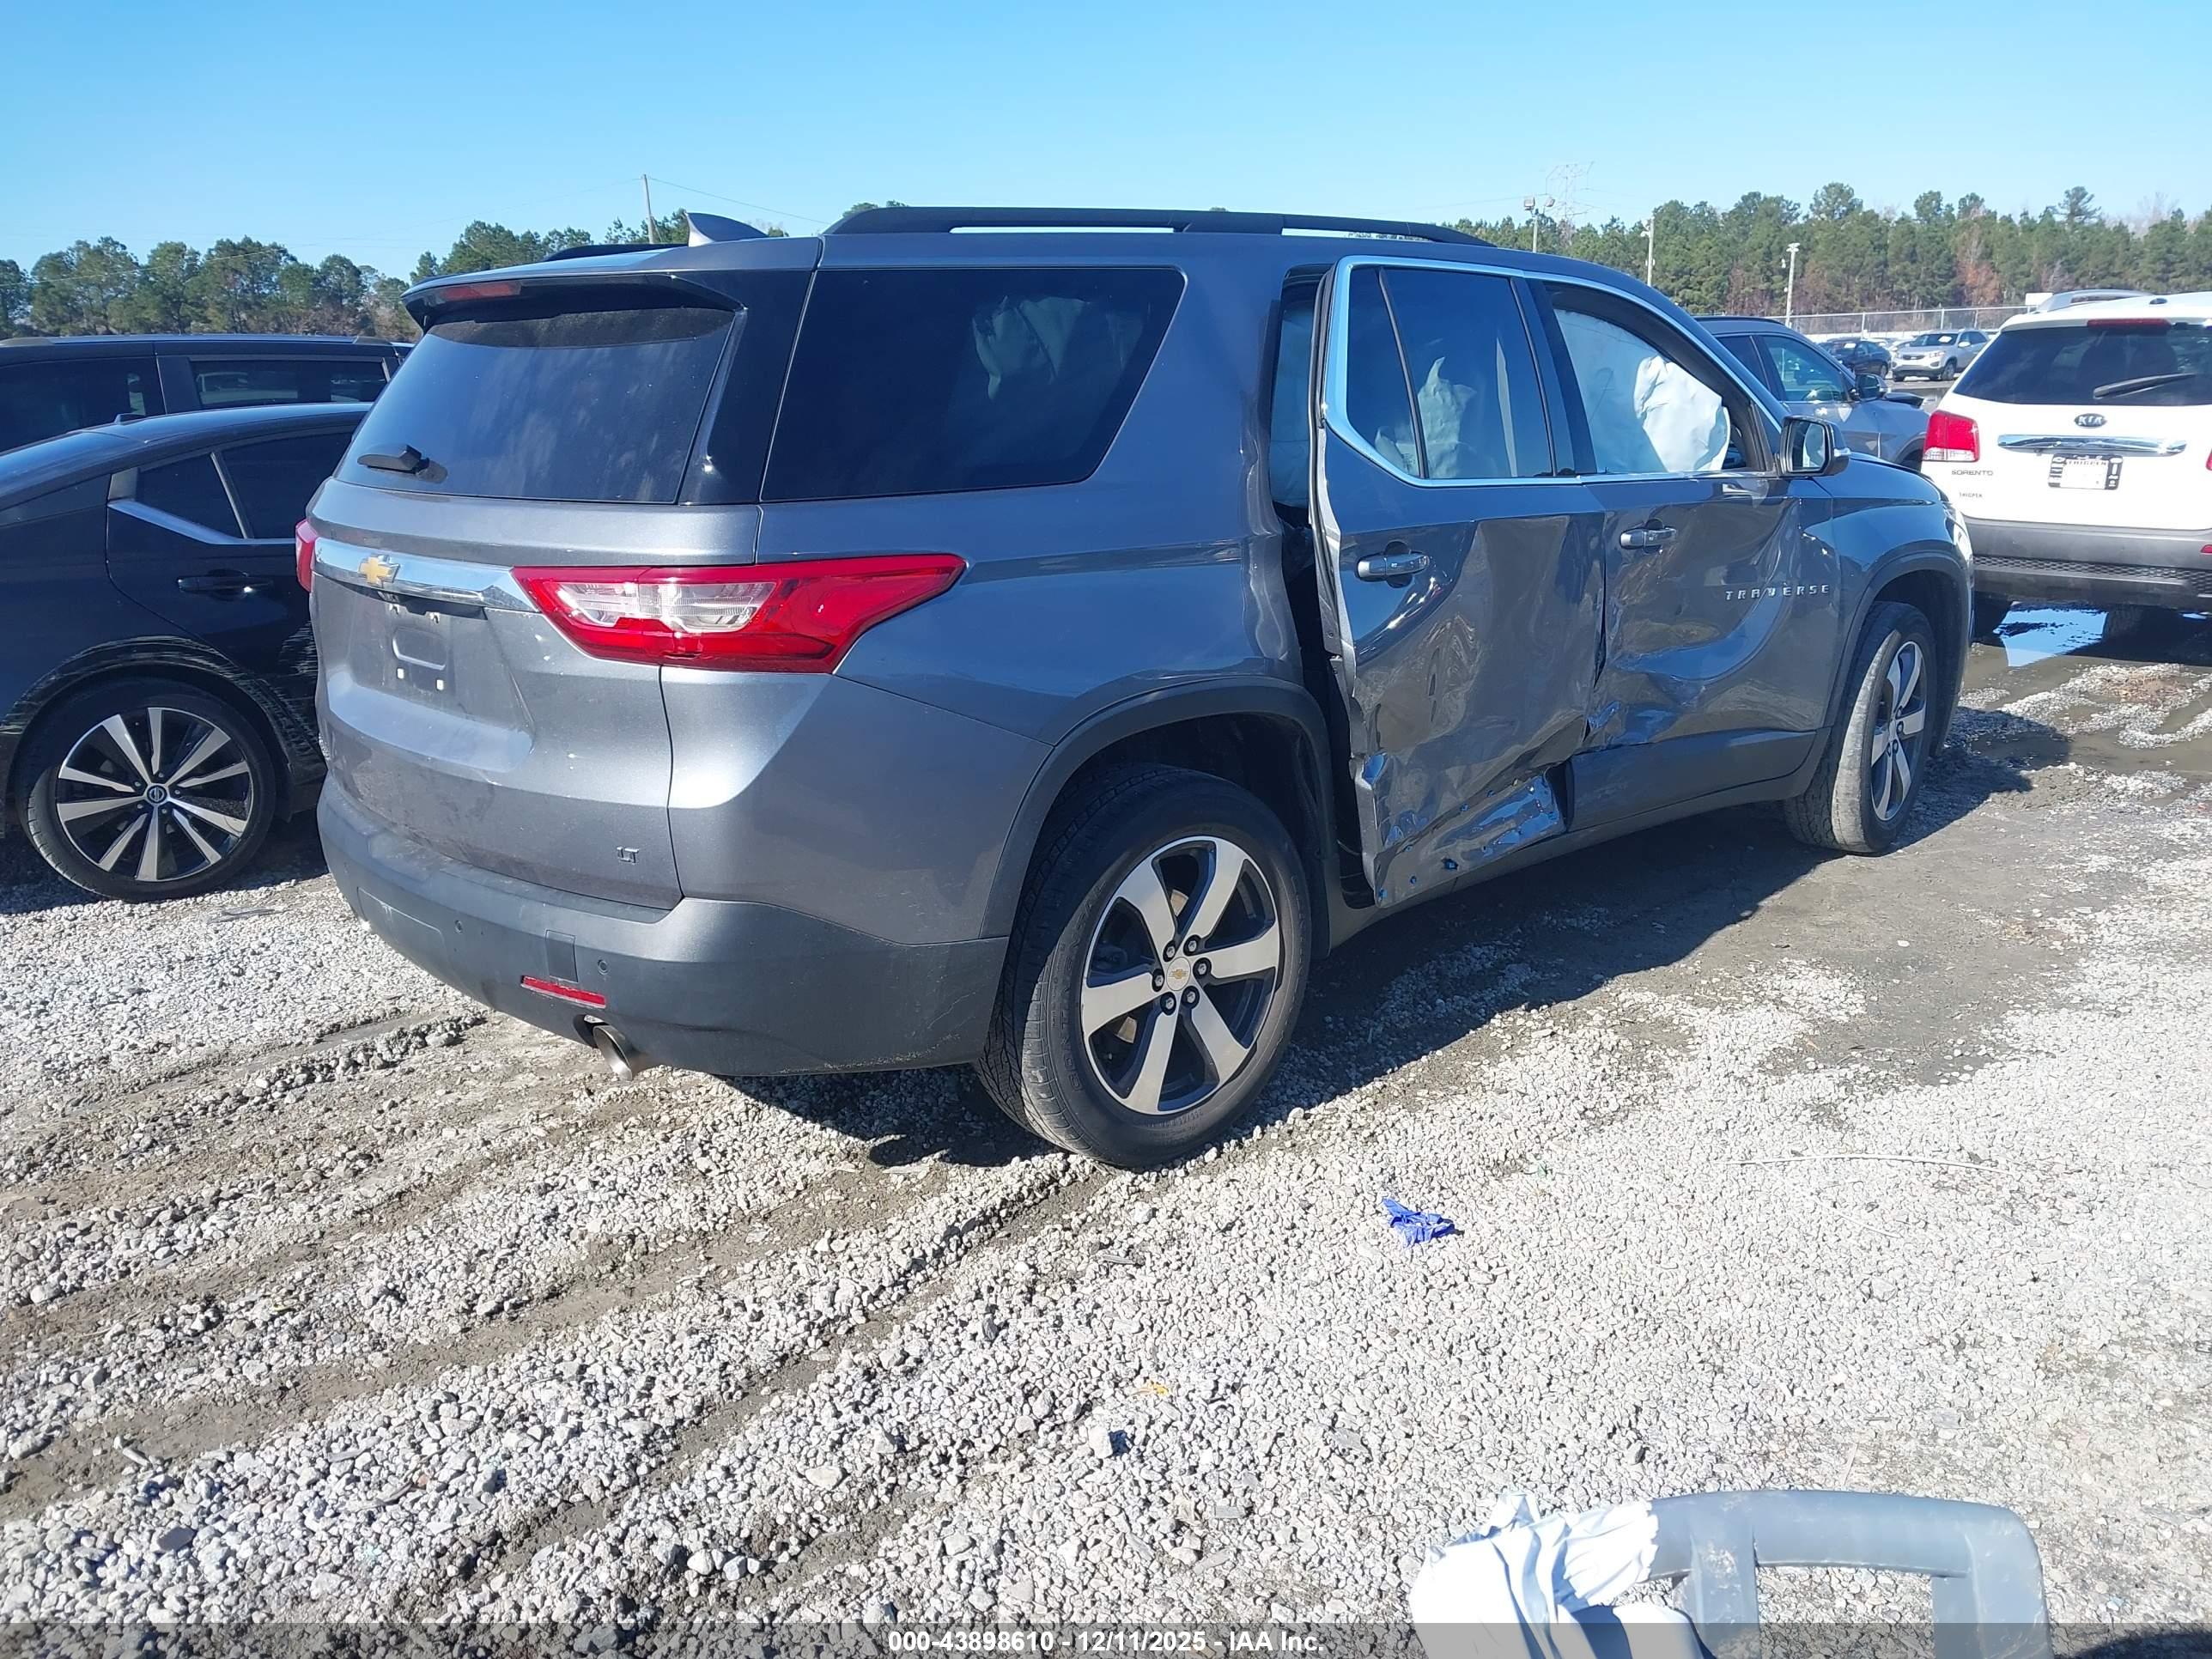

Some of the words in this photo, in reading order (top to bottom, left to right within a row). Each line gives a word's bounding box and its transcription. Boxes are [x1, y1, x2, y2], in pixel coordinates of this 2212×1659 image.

[2078, 416, 2103, 426] KIA
[1724, 584, 1830, 601] TRAVERSE
[617, 846, 640, 866] LT
